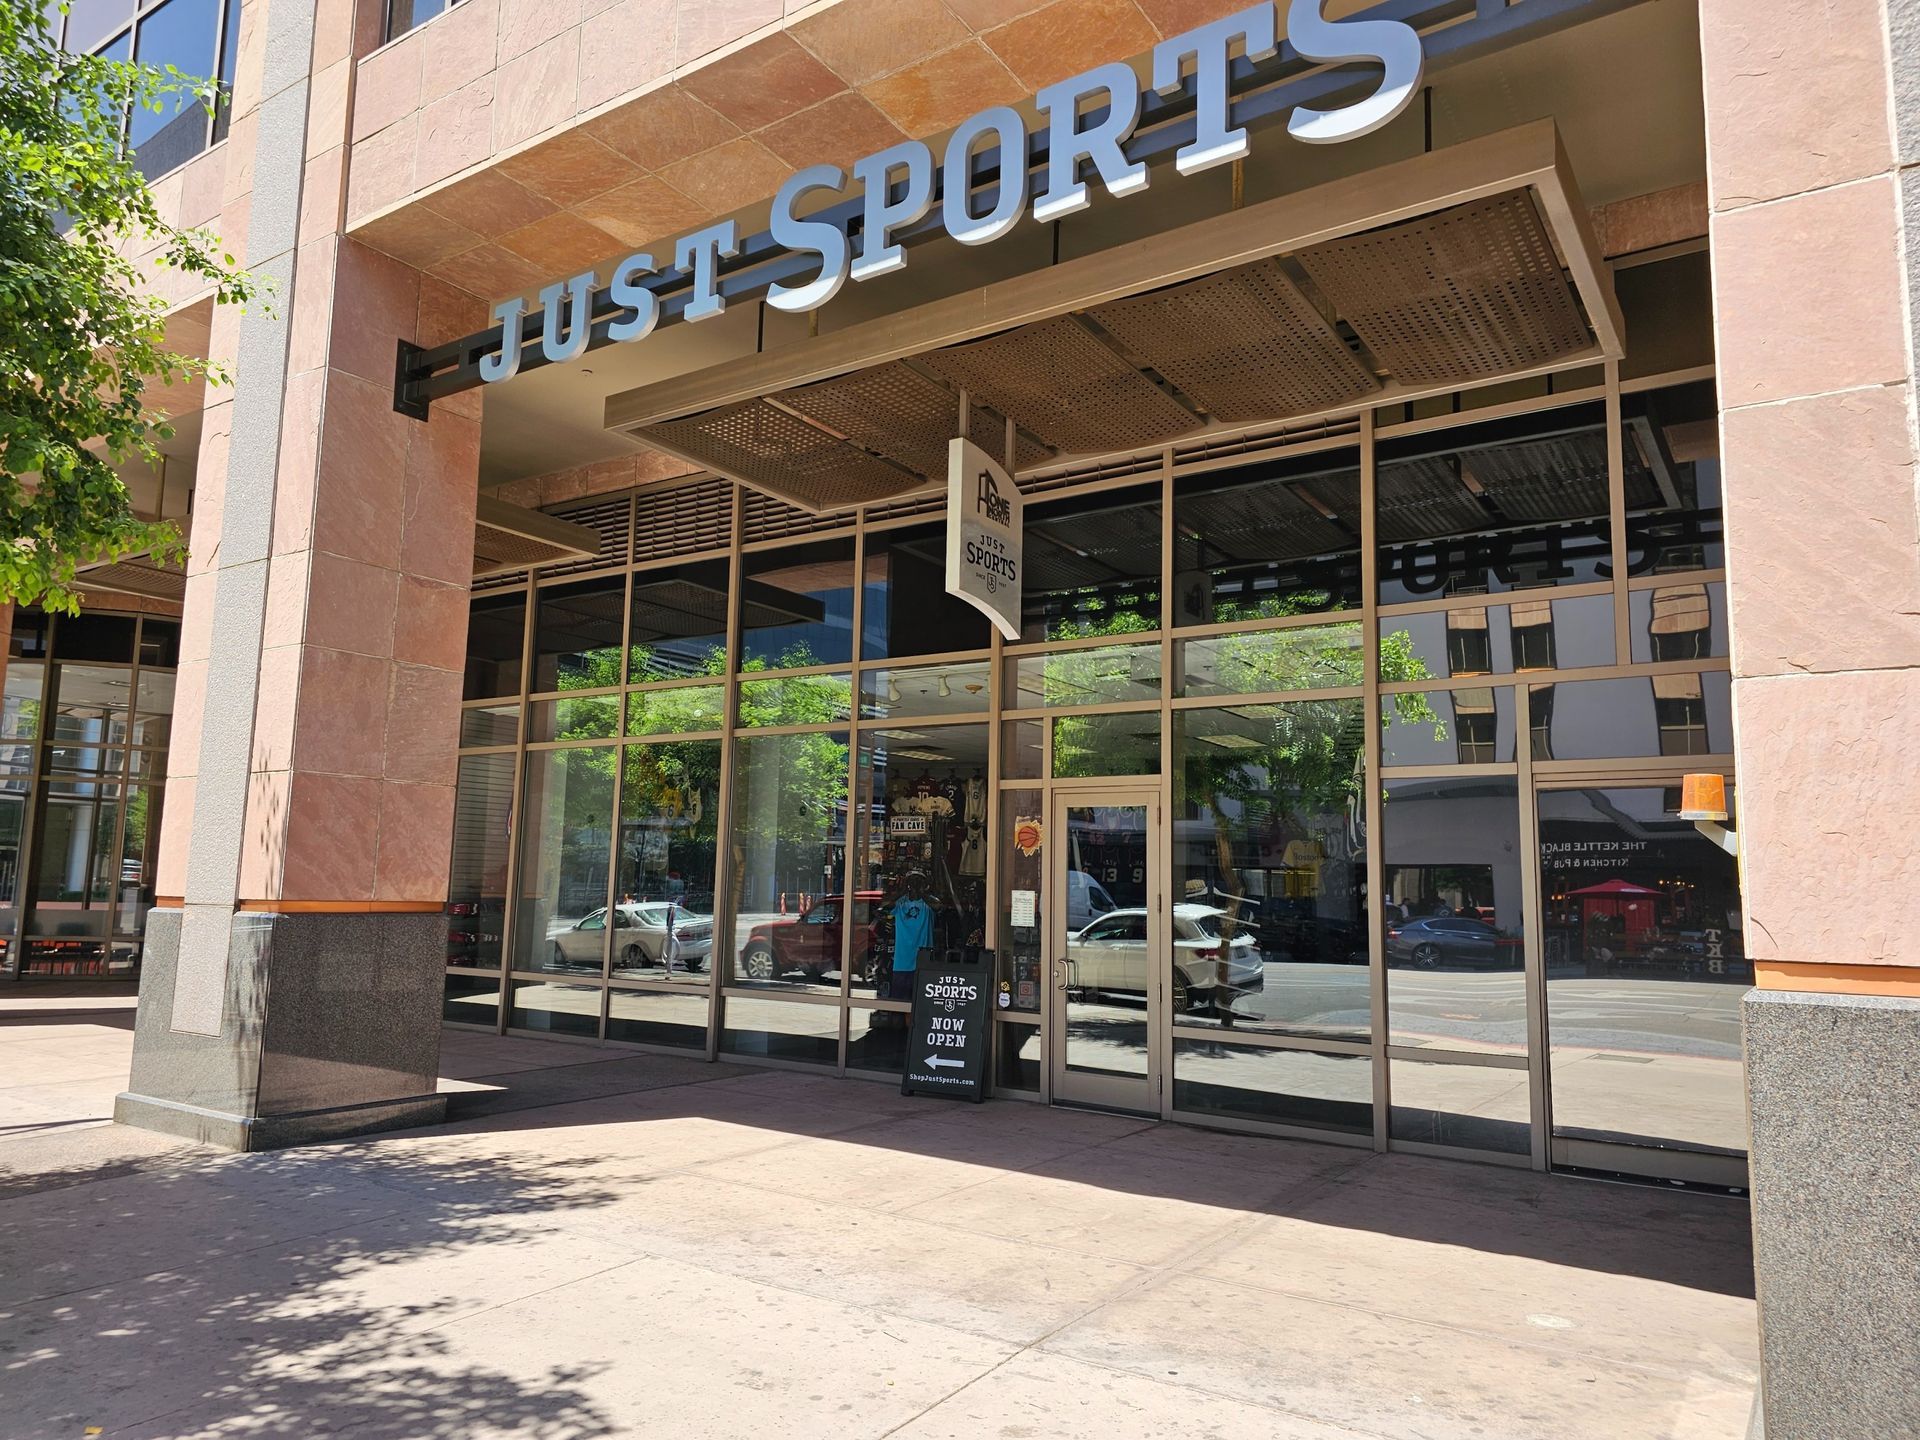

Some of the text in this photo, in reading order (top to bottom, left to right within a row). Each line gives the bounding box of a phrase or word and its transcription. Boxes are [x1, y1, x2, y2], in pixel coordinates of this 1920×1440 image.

[479, 0, 1423, 384] JUST SPORTS
[990, 493, 1010, 514] ONE
[980, 535, 1005, 554] JUST
[967, 541, 1016, 581] SPORTS
[891, 821, 925, 830] FAN CAVE
[938, 976, 966, 985] JUST
[925, 983, 977, 1000] SPORTS
[931, 1017, 965, 1031] NOW
[927, 1032, 967, 1047] OPEN
[909, 1073, 975, 1086] ShopJustSports.com
